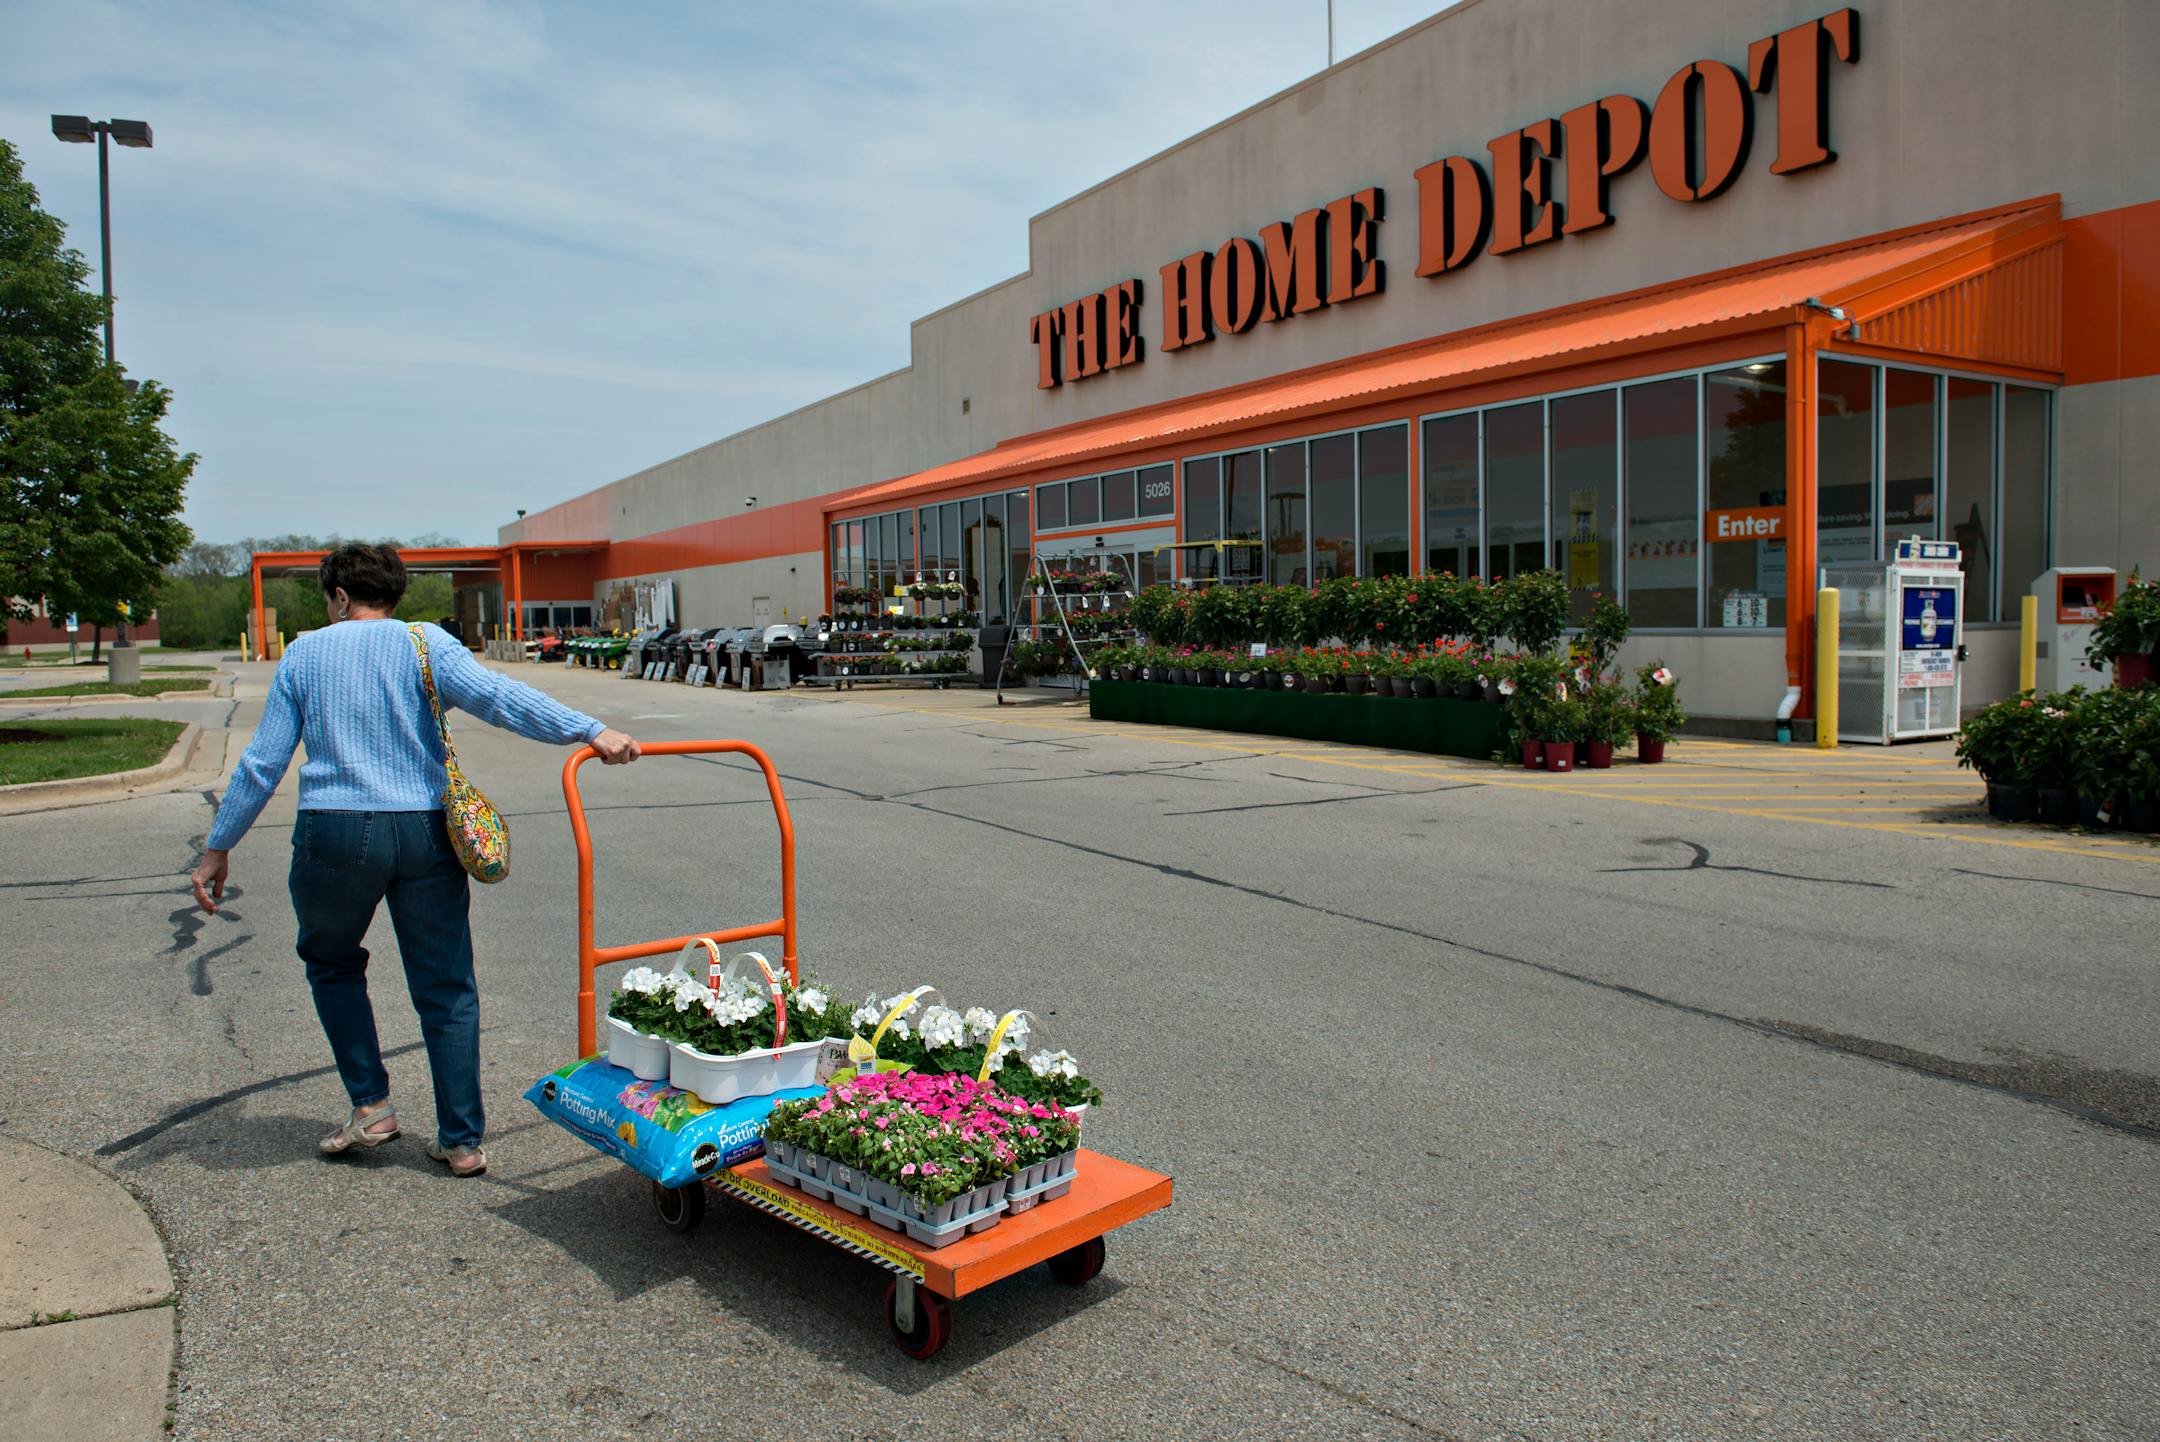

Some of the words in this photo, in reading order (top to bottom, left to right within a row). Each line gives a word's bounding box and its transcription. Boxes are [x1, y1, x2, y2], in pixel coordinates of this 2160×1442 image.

[1030, 278, 1144, 390] THE
[1160, 186, 1388, 354] HOME
[1413, 7, 1860, 279] DEPOT
[1145, 481, 1171, 499] 5026
[1718, 514, 1781, 537] Enter
[560, 1091, 596, 1124] Potting
[597, 1107, 616, 1129] Mix
[692, 1150, 720, 1169] Miracle-Gro
[730, 1175, 741, 1186] OR
[743, 1180, 790, 1208] OVERLOAD
